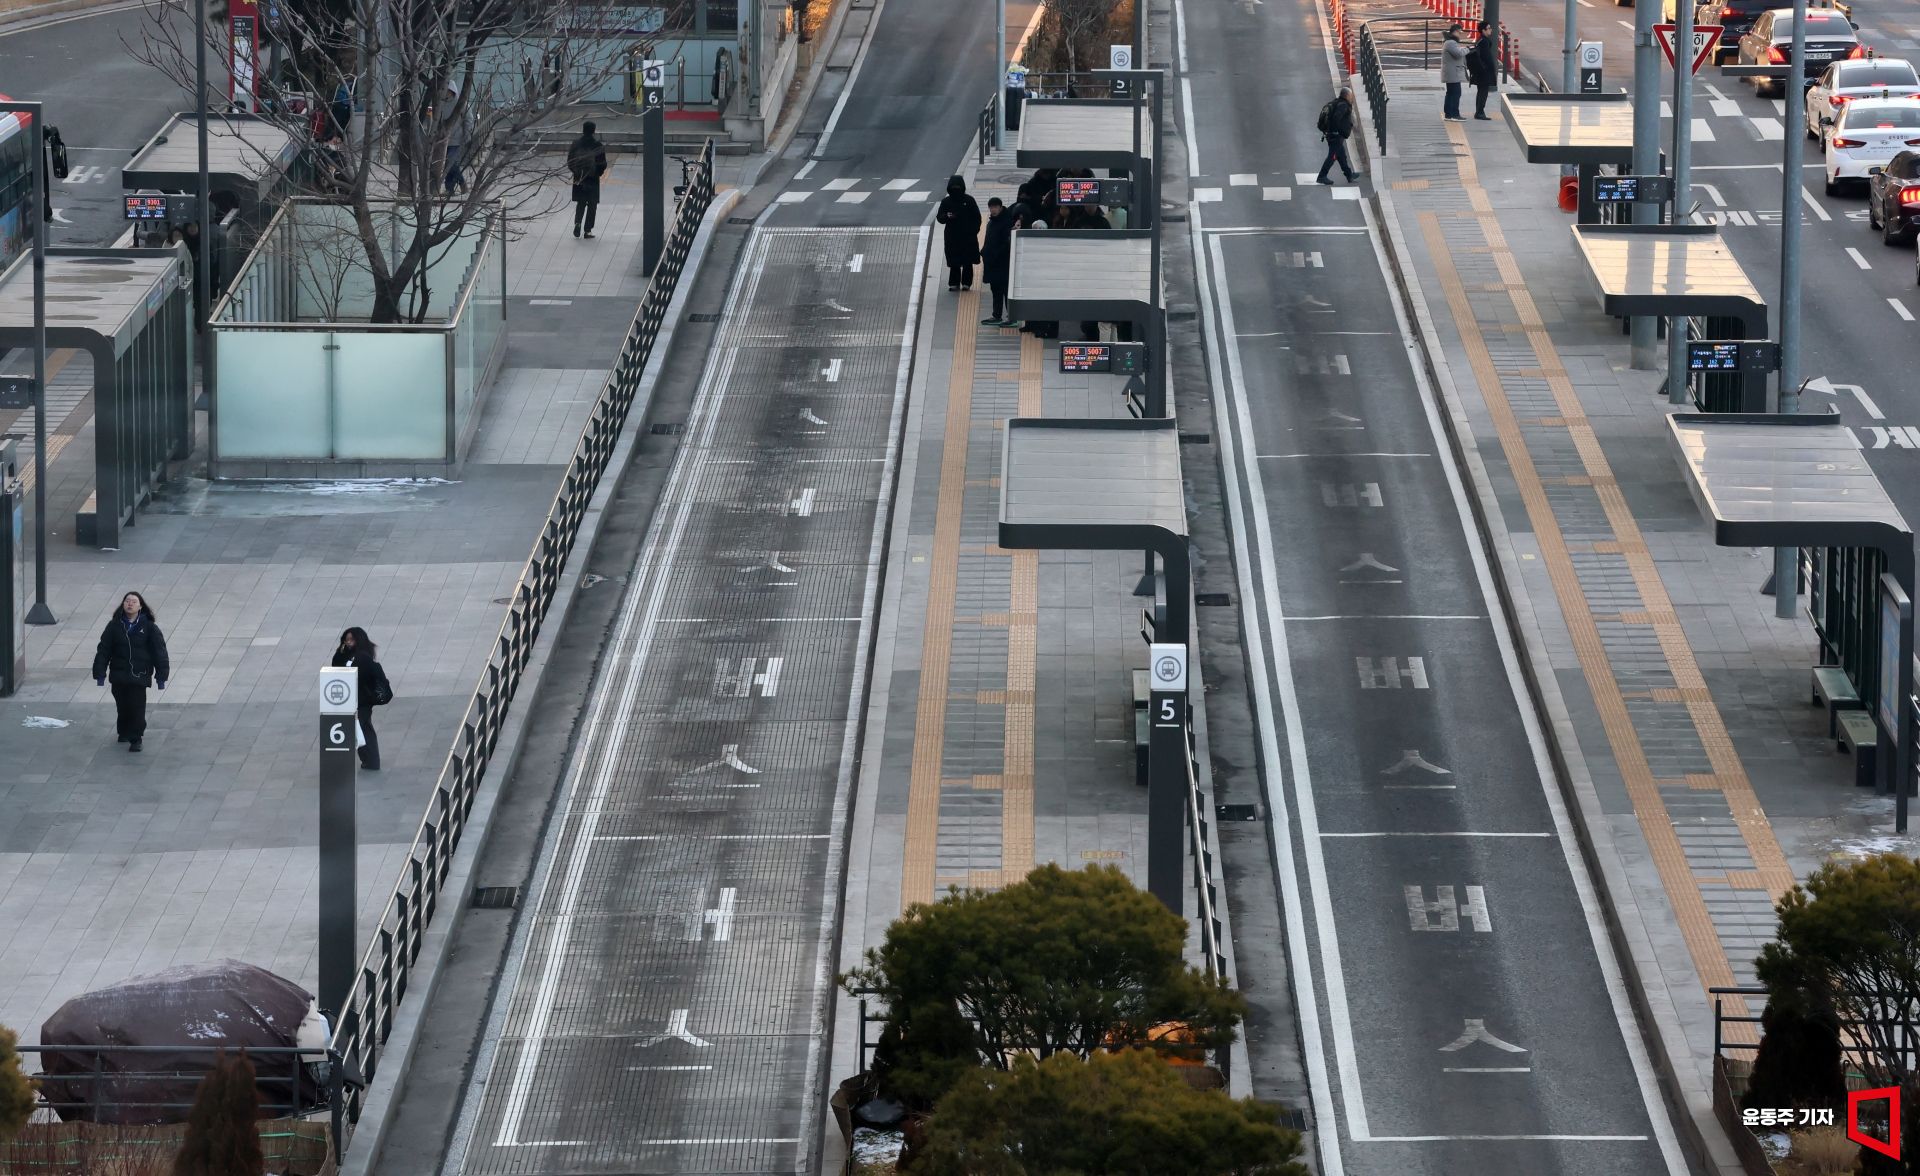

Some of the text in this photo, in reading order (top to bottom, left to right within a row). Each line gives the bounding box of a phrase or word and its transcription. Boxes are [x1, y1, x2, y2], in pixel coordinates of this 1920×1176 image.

[1586, 72, 1597, 86] 4
[648, 91, 658, 104] 6
[1160, 699, 1175, 721] 5
[329, 722, 346, 744] 6
[1403, 885, 1531, 1073] 버스
